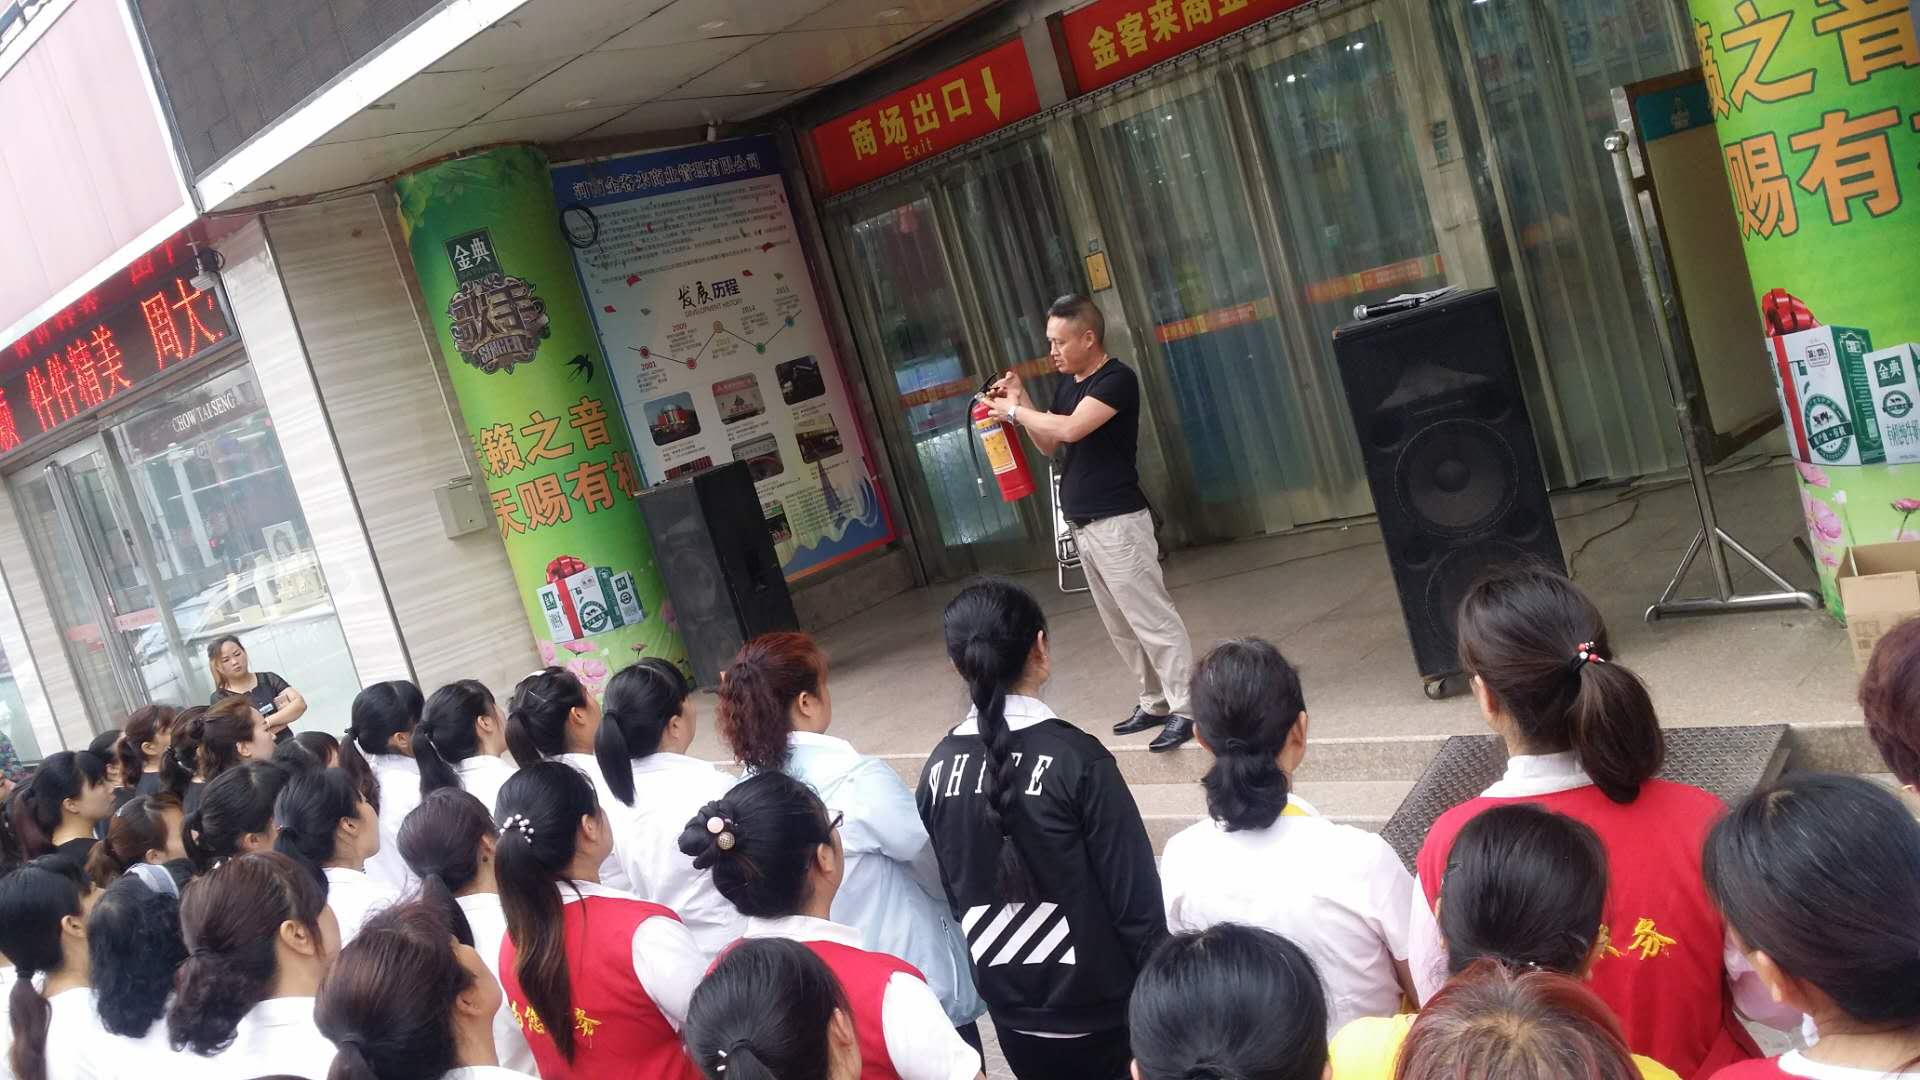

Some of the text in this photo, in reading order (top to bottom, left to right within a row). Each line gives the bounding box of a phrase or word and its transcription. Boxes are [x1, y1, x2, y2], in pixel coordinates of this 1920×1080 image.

[848, 78, 972, 160] 商场出口
[903, 137, 933, 160] Exit
[453, 236, 491, 272] 金典
[678, 278, 741, 310] 发展历程
[25, 324, 133, 433] 件件精美
[1877, 359, 1903, 381] 金典
[172, 391, 237, 433] CHOW TAI SENG
[929, 752, 1054, 805] WHIE
